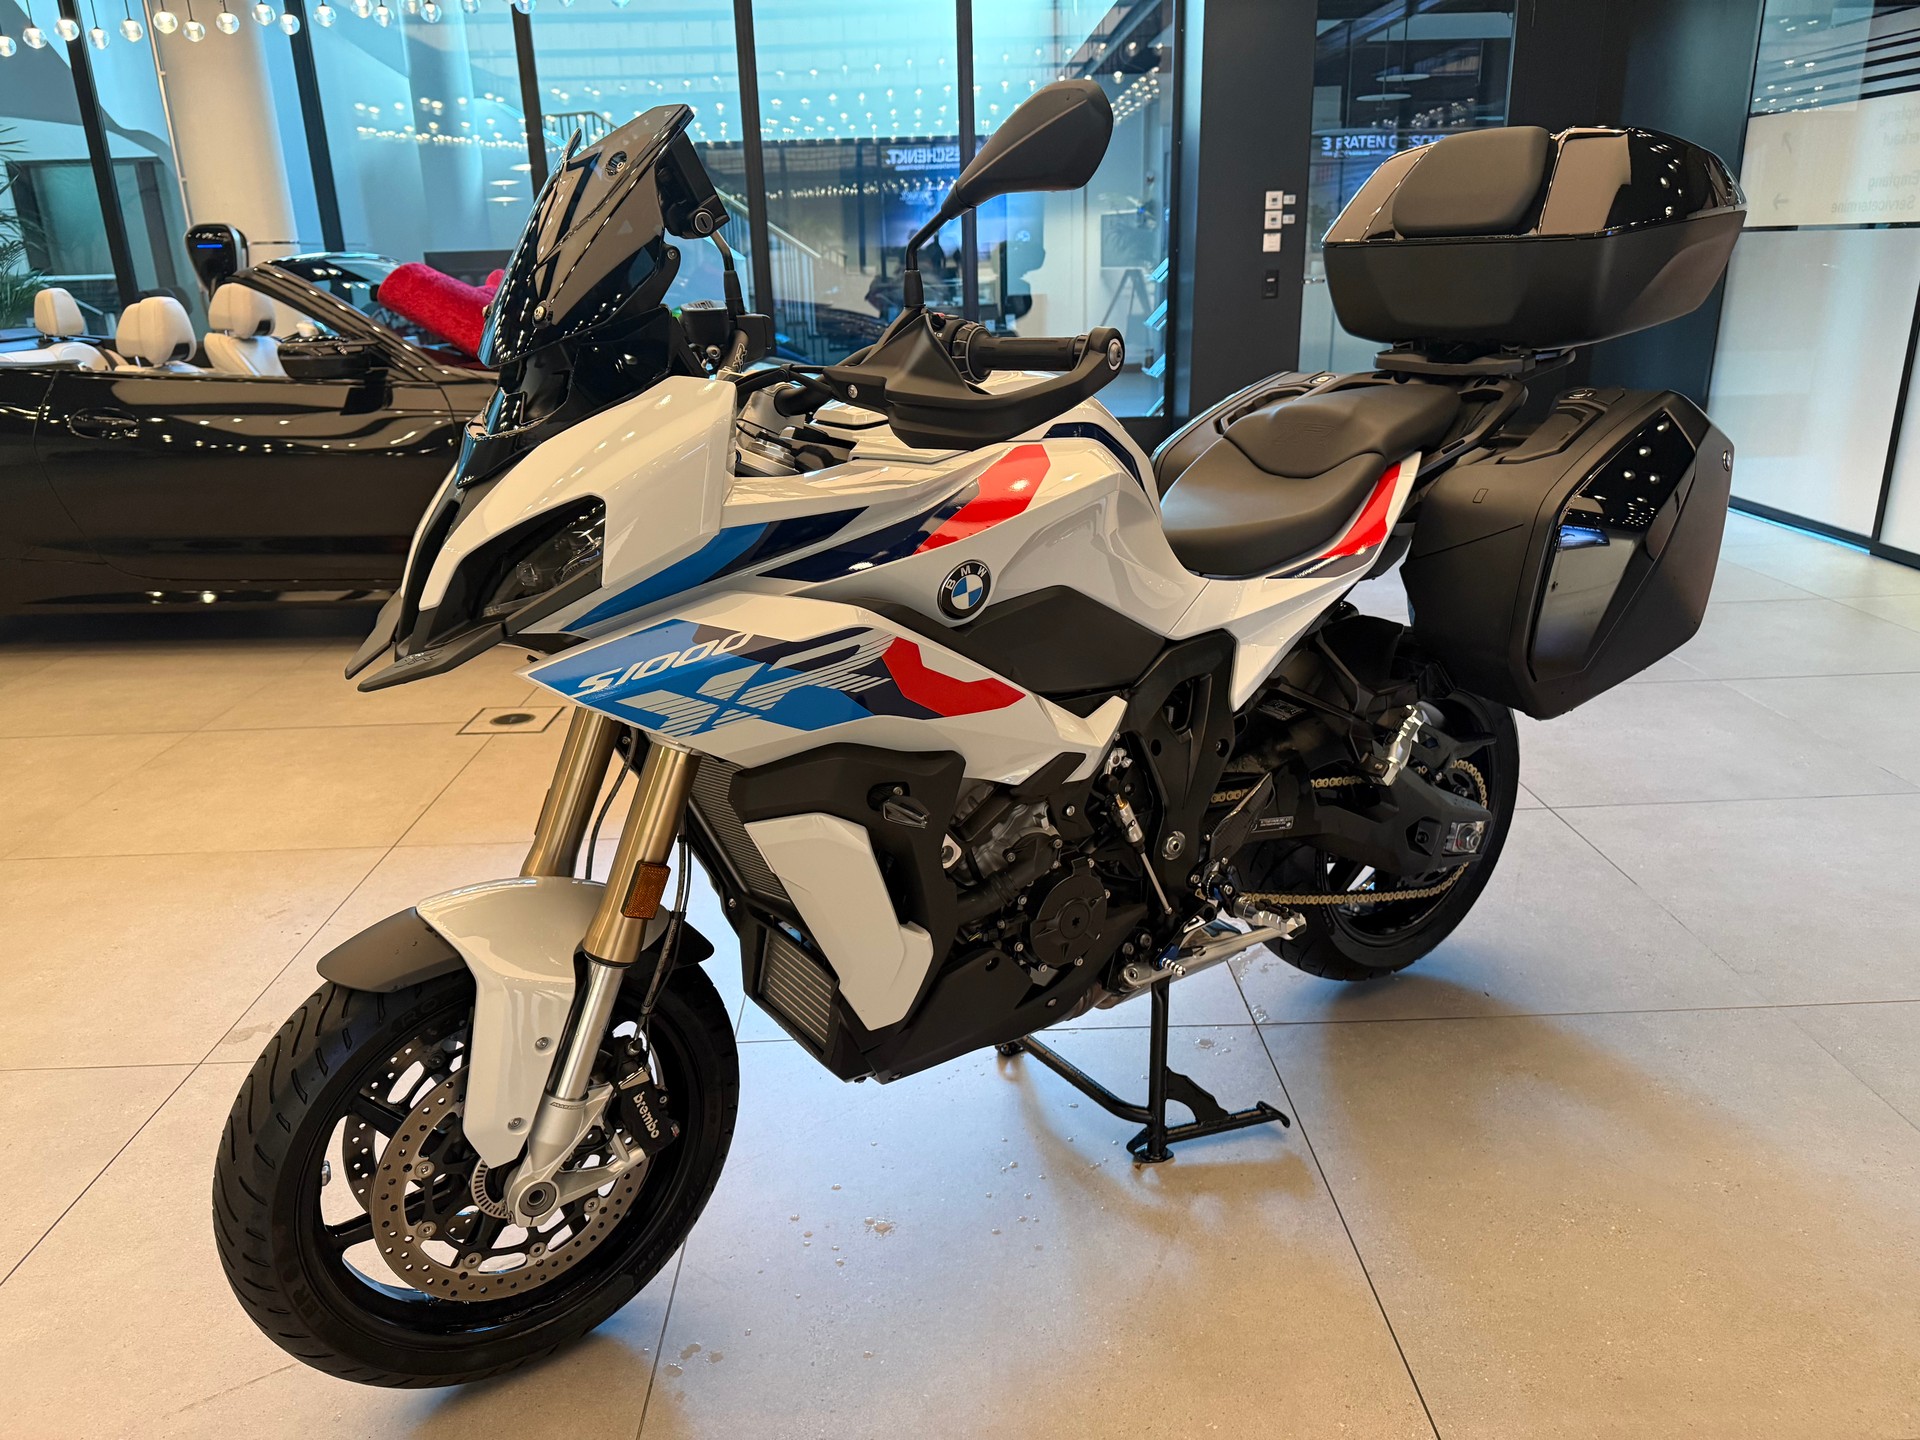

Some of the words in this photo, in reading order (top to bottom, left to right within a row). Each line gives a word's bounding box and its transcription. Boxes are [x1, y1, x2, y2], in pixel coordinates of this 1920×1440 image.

[1321, 136, 1332, 151] 3
[945, 564, 988, 591] BMW
[632, 1090, 661, 1139] brembo
